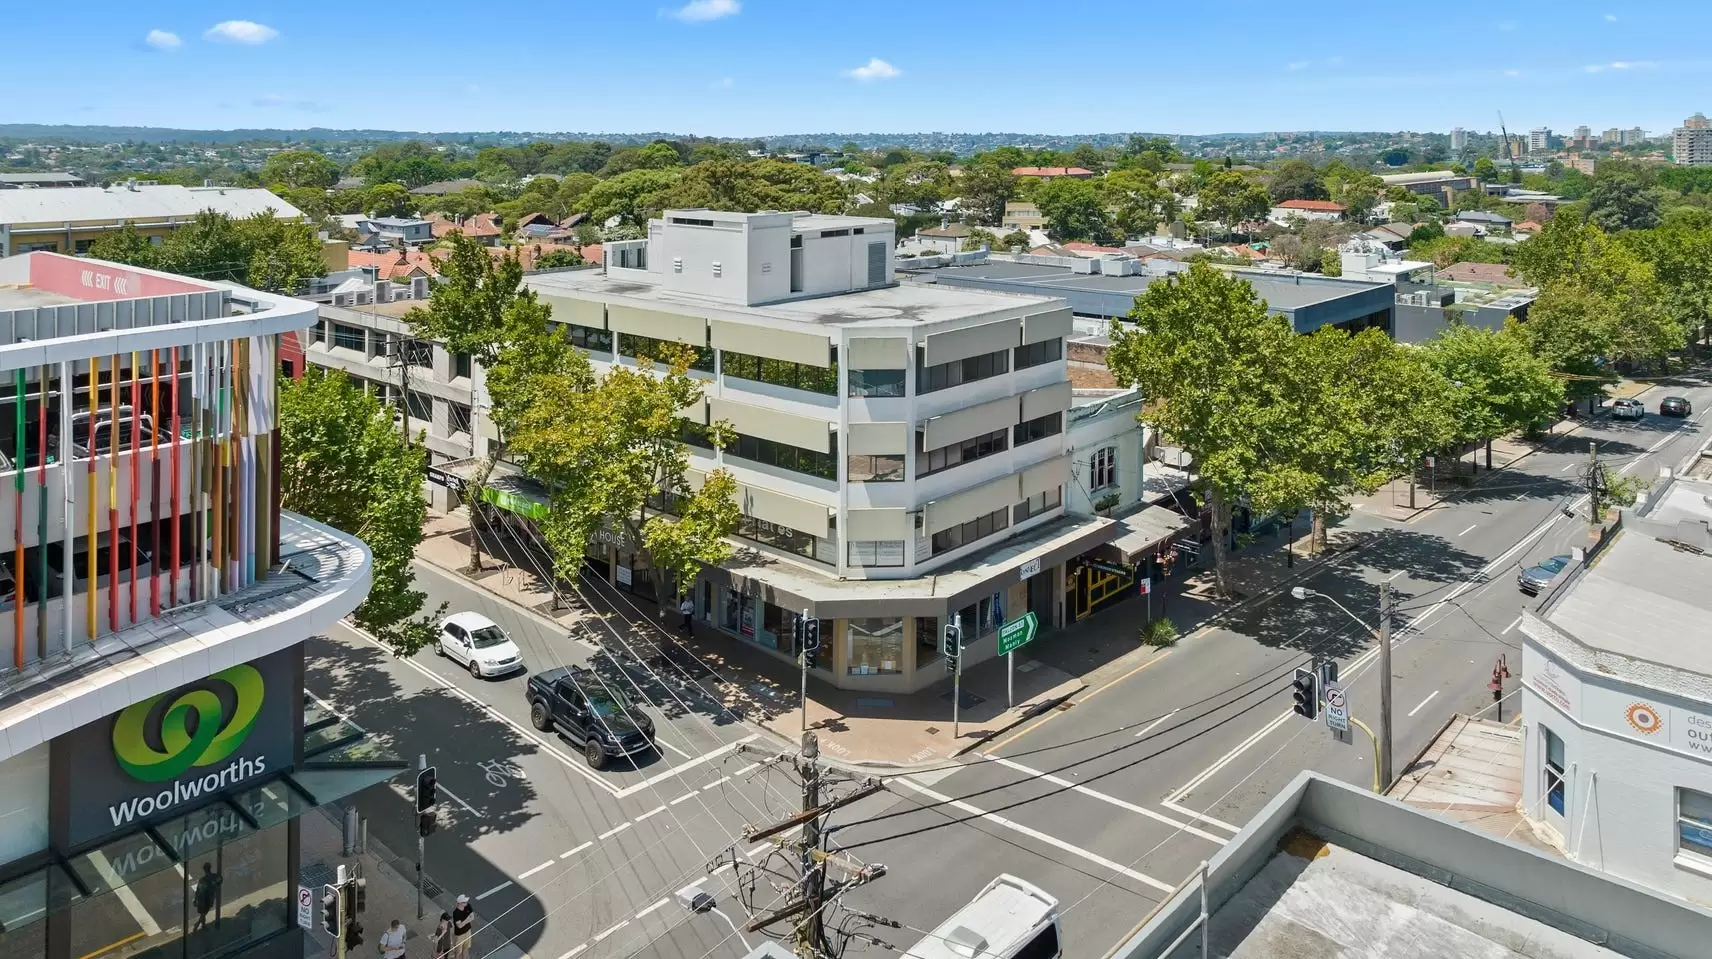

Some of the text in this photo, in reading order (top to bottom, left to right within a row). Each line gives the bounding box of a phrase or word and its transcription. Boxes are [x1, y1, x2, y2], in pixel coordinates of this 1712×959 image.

[96, 273, 111, 290] EXIT
[600, 530, 625, 547] HOUSE
[1331, 707, 1342, 716] NO
[109, 755, 265, 827] Woolworths
